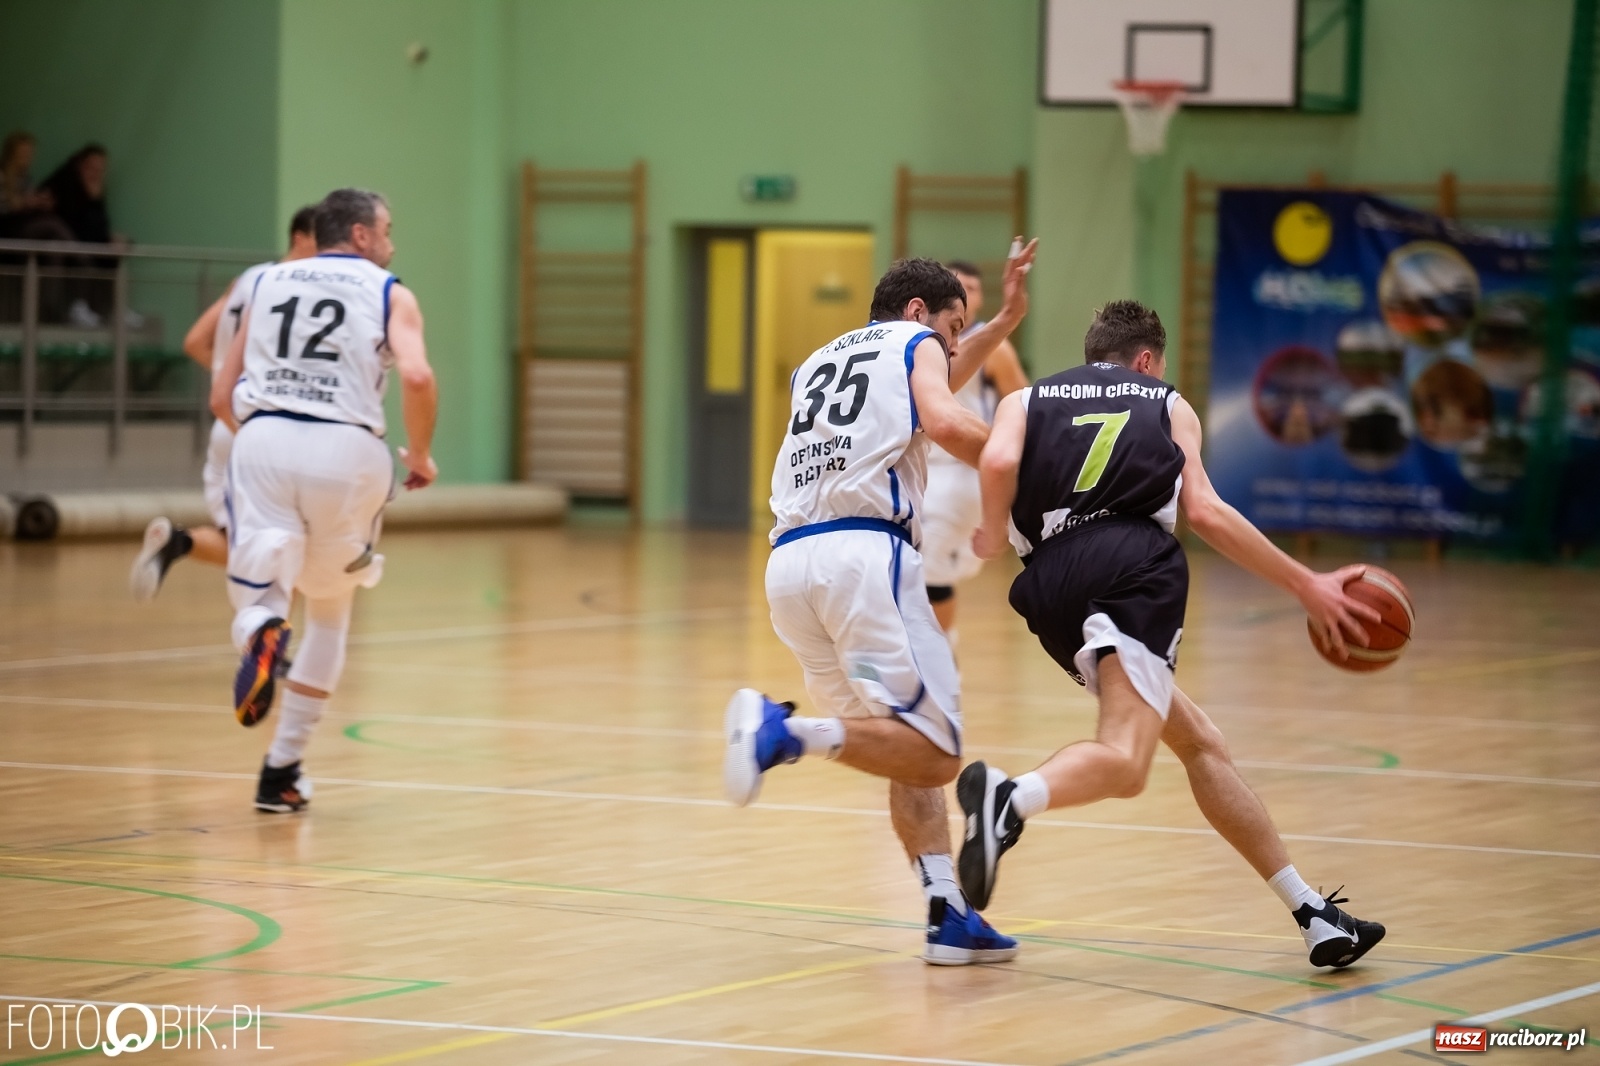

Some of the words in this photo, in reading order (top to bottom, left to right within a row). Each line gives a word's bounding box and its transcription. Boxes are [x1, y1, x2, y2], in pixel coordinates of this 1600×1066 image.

[270, 296, 345, 361] 12
[834, 329, 893, 351] SZKLARZ
[791, 351, 881, 435] 35
[1038, 384, 1102, 399] NACOMI
[1105, 382, 1168, 400] CIESZYN
[1072, 409, 1131, 493] 7
